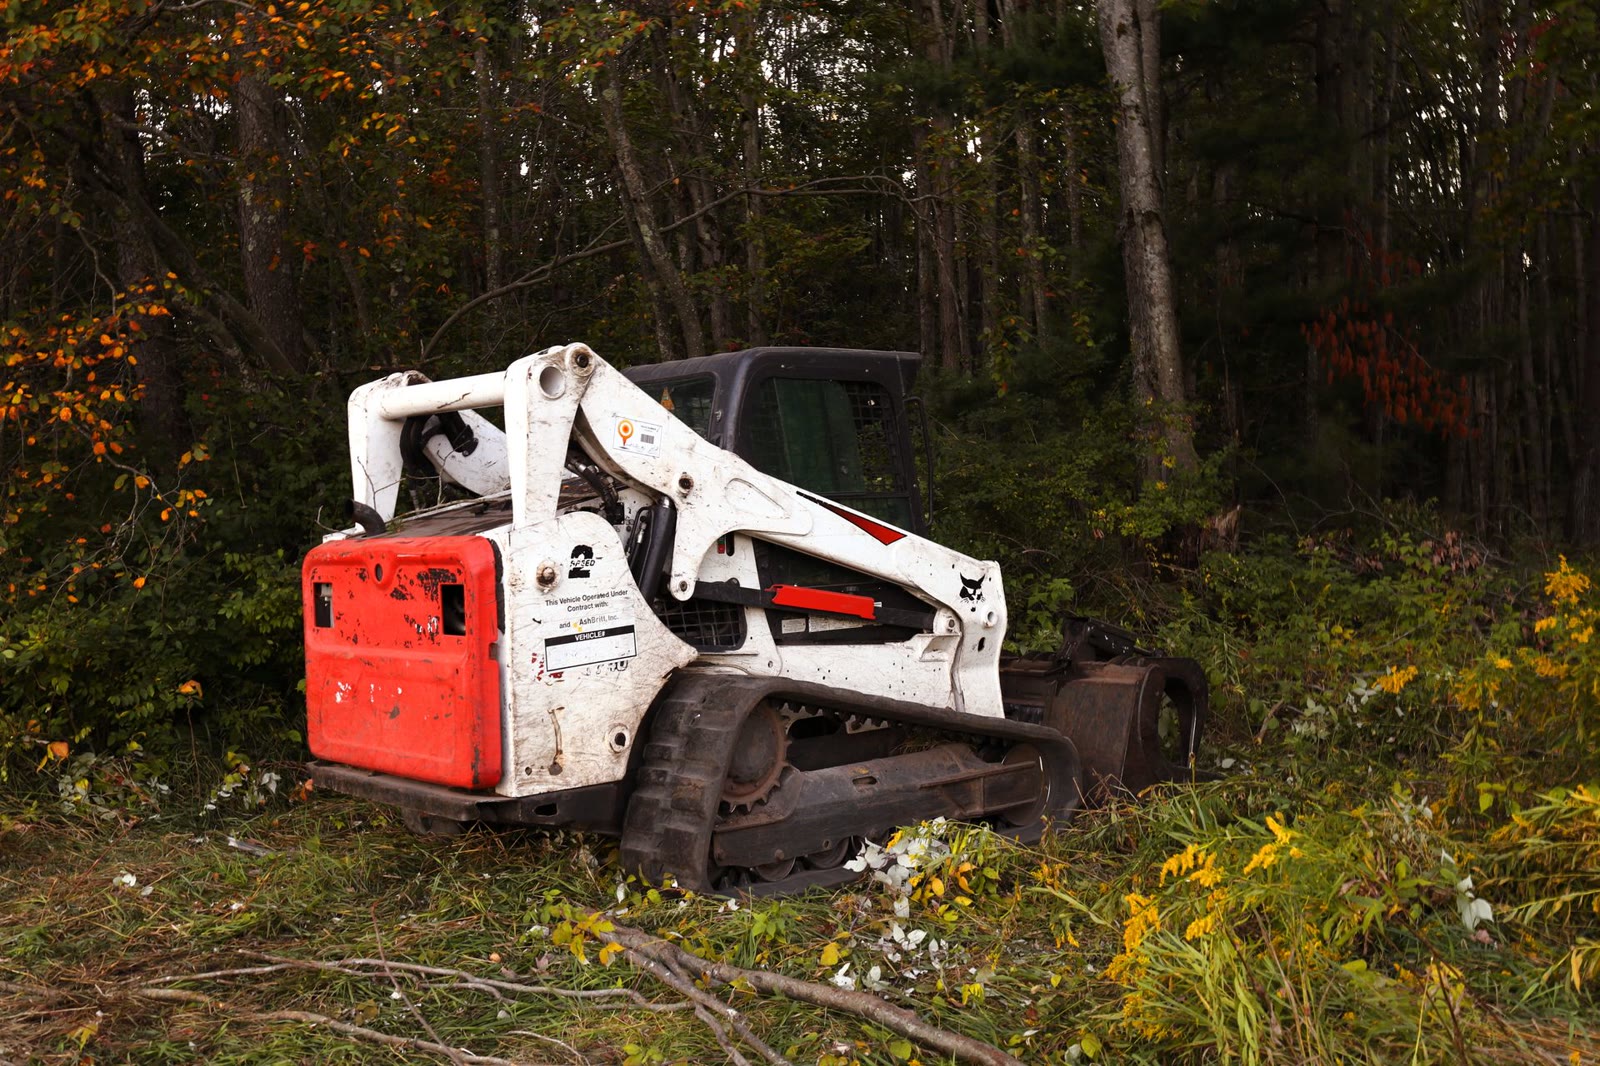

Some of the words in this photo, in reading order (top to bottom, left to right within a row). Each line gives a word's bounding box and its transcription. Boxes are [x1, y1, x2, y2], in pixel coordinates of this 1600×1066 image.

[568, 544, 594, 579] 2
[559, 596, 581, 605] Vehicle
[582, 592, 609, 602] Operated
[610, 589, 628, 598] Under
[567, 603, 593, 612] Contract
